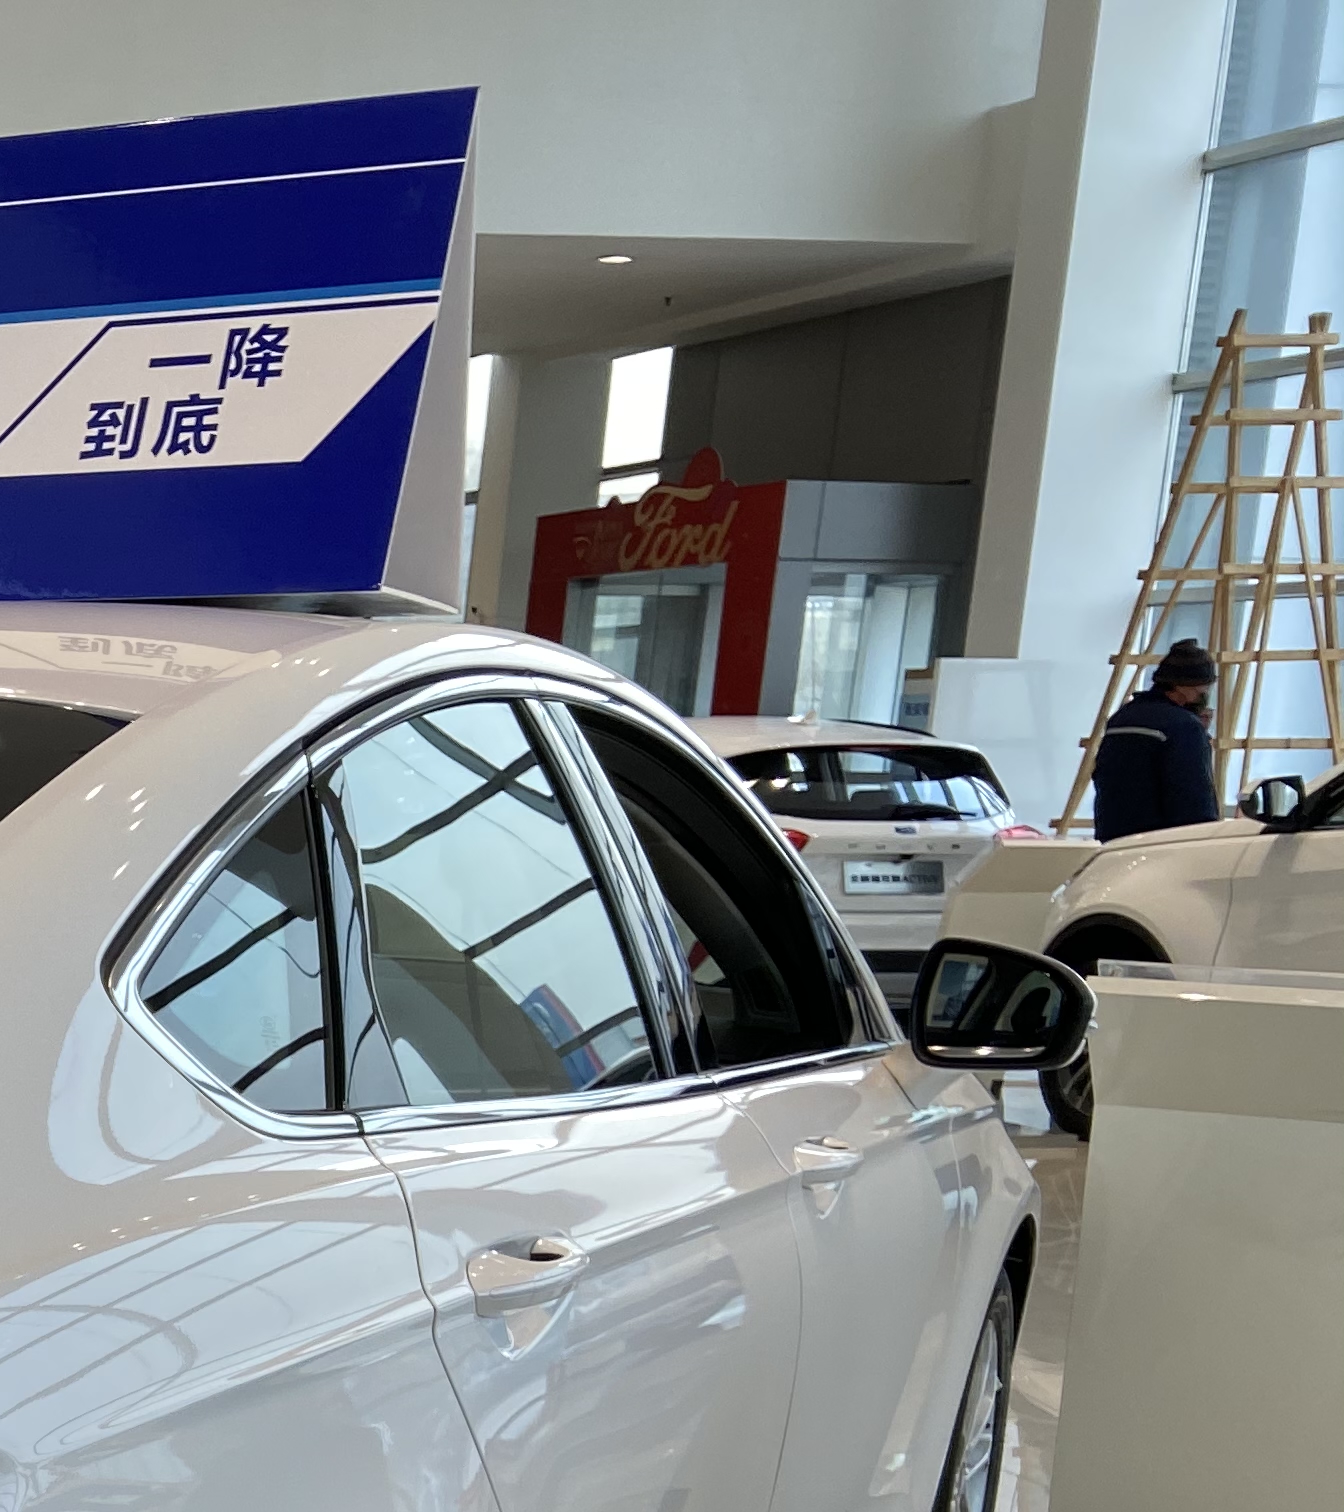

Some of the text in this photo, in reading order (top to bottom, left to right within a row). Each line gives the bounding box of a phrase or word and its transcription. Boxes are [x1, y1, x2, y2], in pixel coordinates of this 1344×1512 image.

[148, 324, 290, 390] 一降
[78, 393, 224, 460] 到底
[618, 485, 739, 571] Ford
